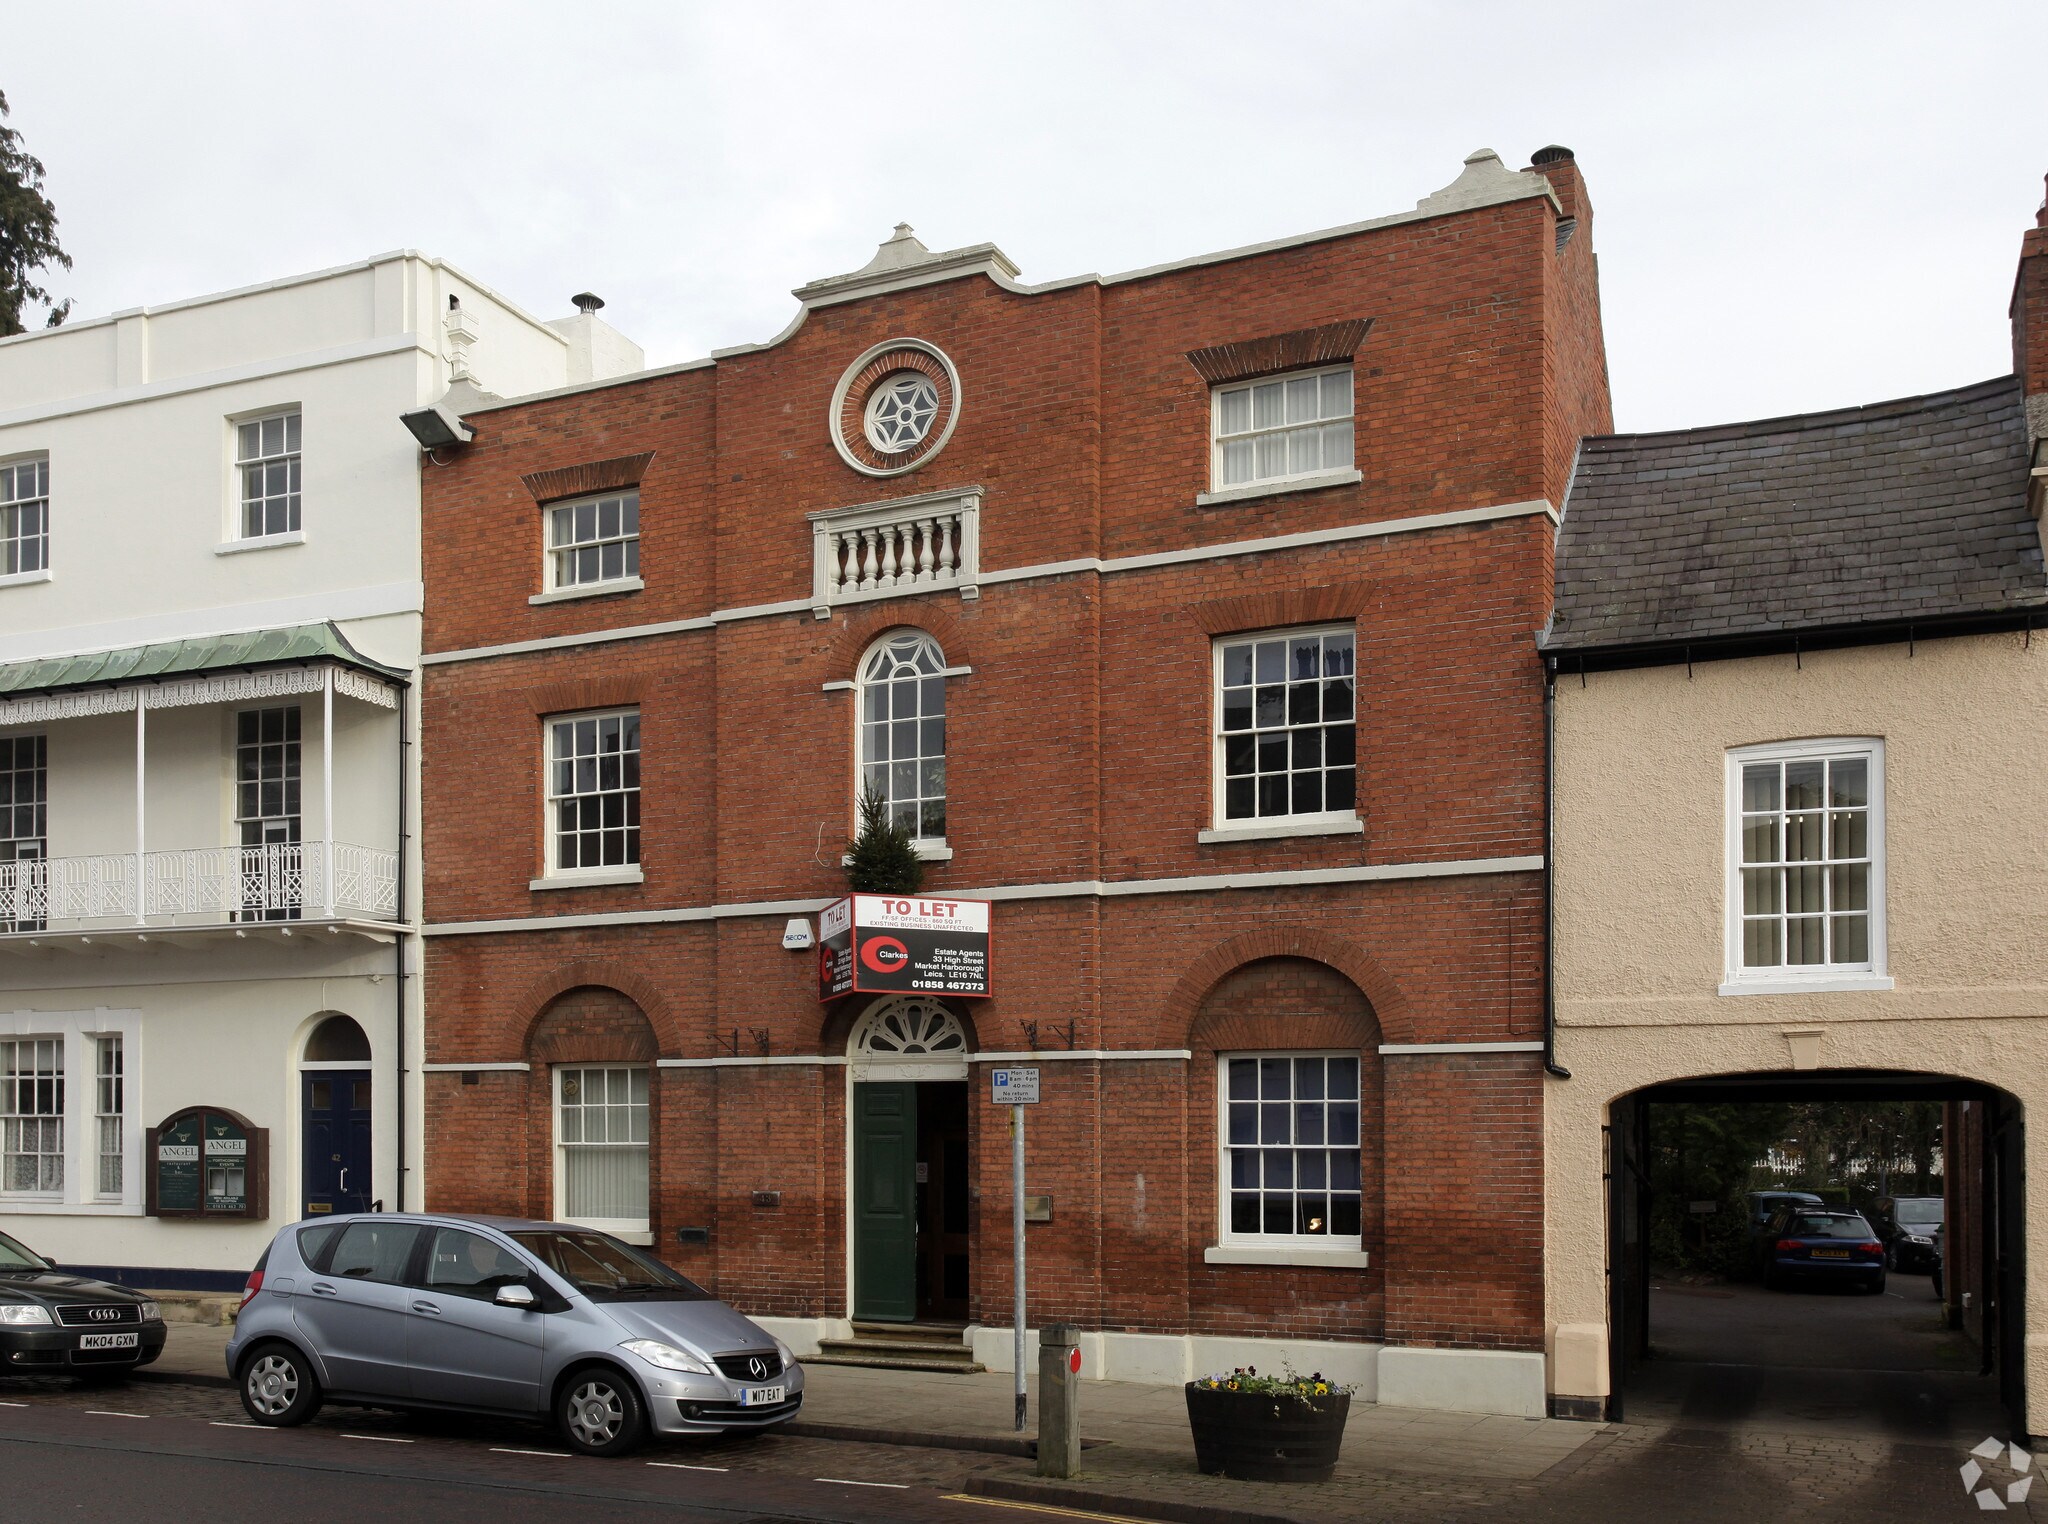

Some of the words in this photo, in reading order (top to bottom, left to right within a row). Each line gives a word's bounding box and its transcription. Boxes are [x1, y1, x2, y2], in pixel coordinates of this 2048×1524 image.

[836, 904, 846, 921] LET
[882, 900, 912, 915] TO
[920, 902, 958, 917] LET
[880, 951, 908, 959] Clarkes
[941, 964, 984, 972] Harborough
[912, 980, 944, 989] 01858
[947, 982, 984, 990] 467373
[997, 1074, 1006, 1085] P
[208, 1141, 244, 1150] ANGEL
[161, 1148, 197, 1156] ANGEL
[85, 1336, 113, 1347] MK04
[116, 1335, 135, 1346] GXN
[768, 1388, 780, 1400] EAT
